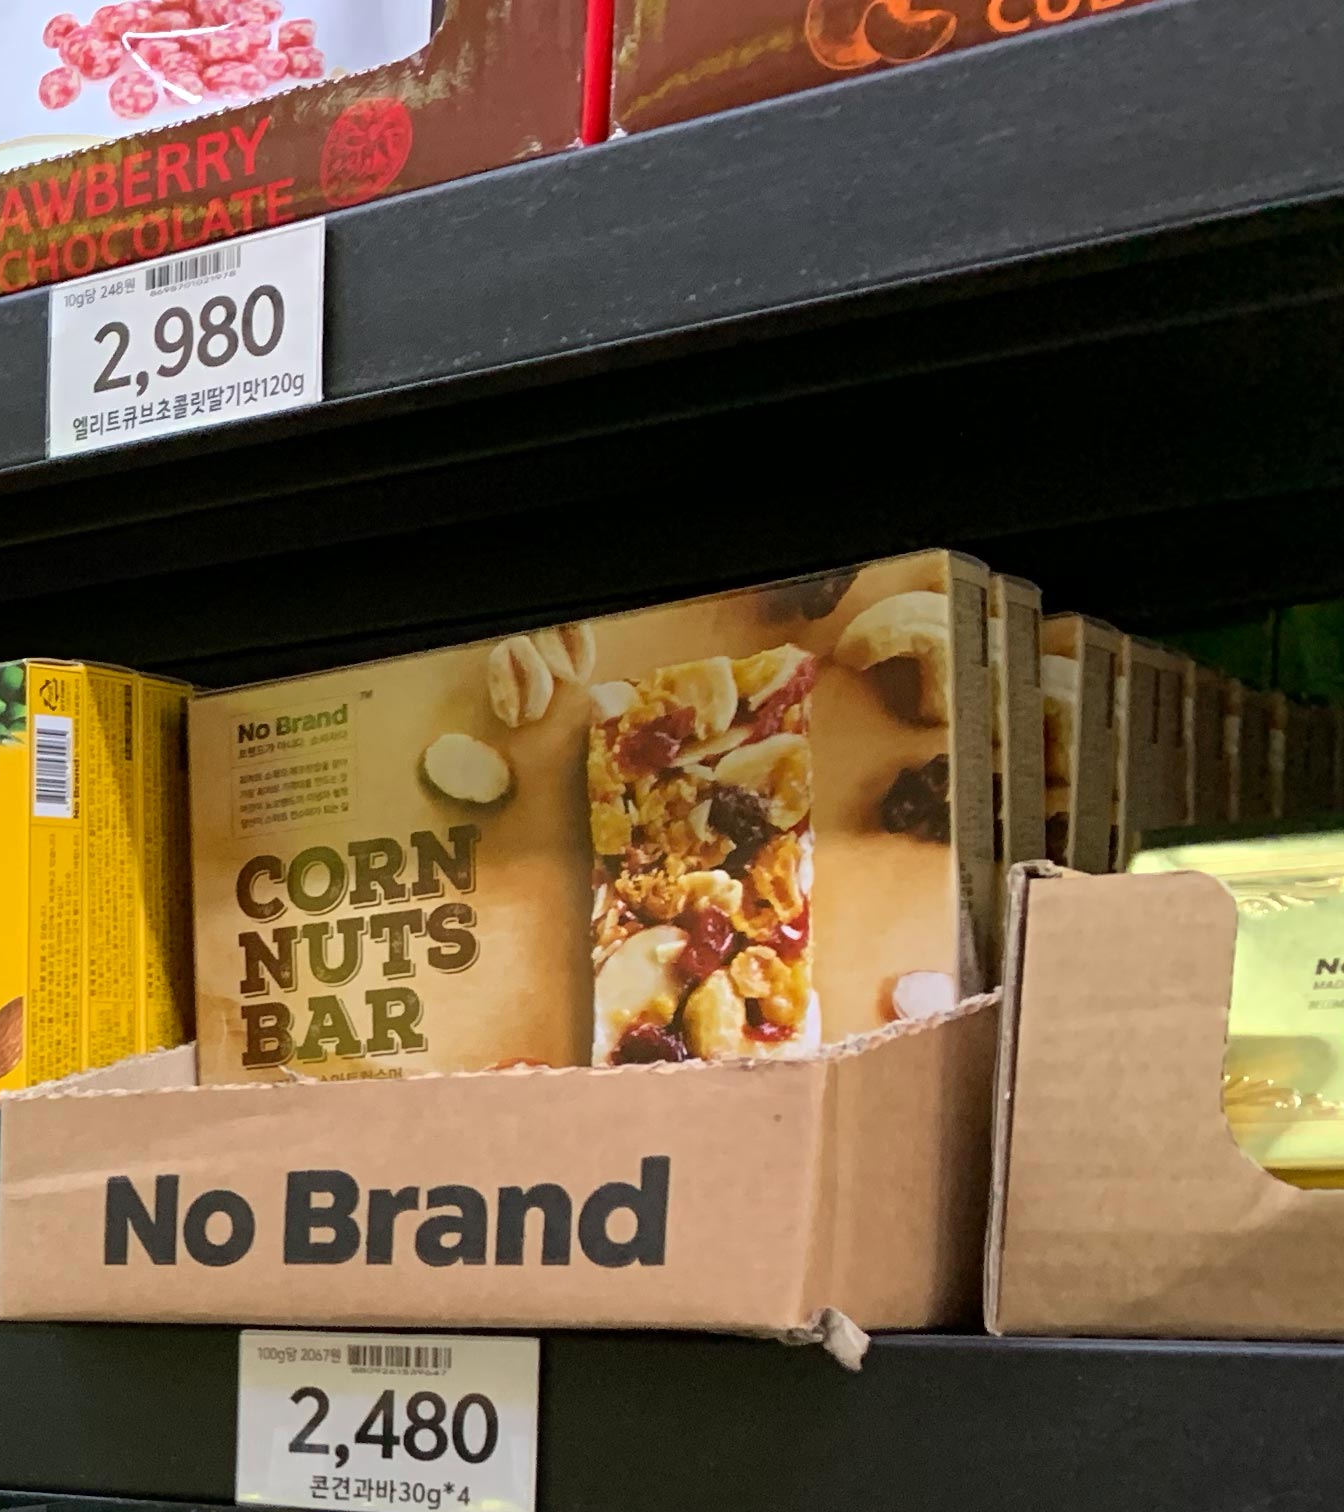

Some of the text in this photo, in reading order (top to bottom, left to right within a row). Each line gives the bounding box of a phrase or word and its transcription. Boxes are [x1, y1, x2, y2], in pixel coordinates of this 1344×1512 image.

[93, 285, 285, 396] 2,980
[73, 373, 304, 441] 엘리트큐브초콜릿딸기맛120g
[238, 723, 270, 744] No
[236, 824, 482, 924] CORN
[237, 902, 482, 999] NUTS
[240, 986, 430, 1071] BAR
[103, 1154, 672, 1268] No Brand
[288, 1386, 499, 1468] 2,480
